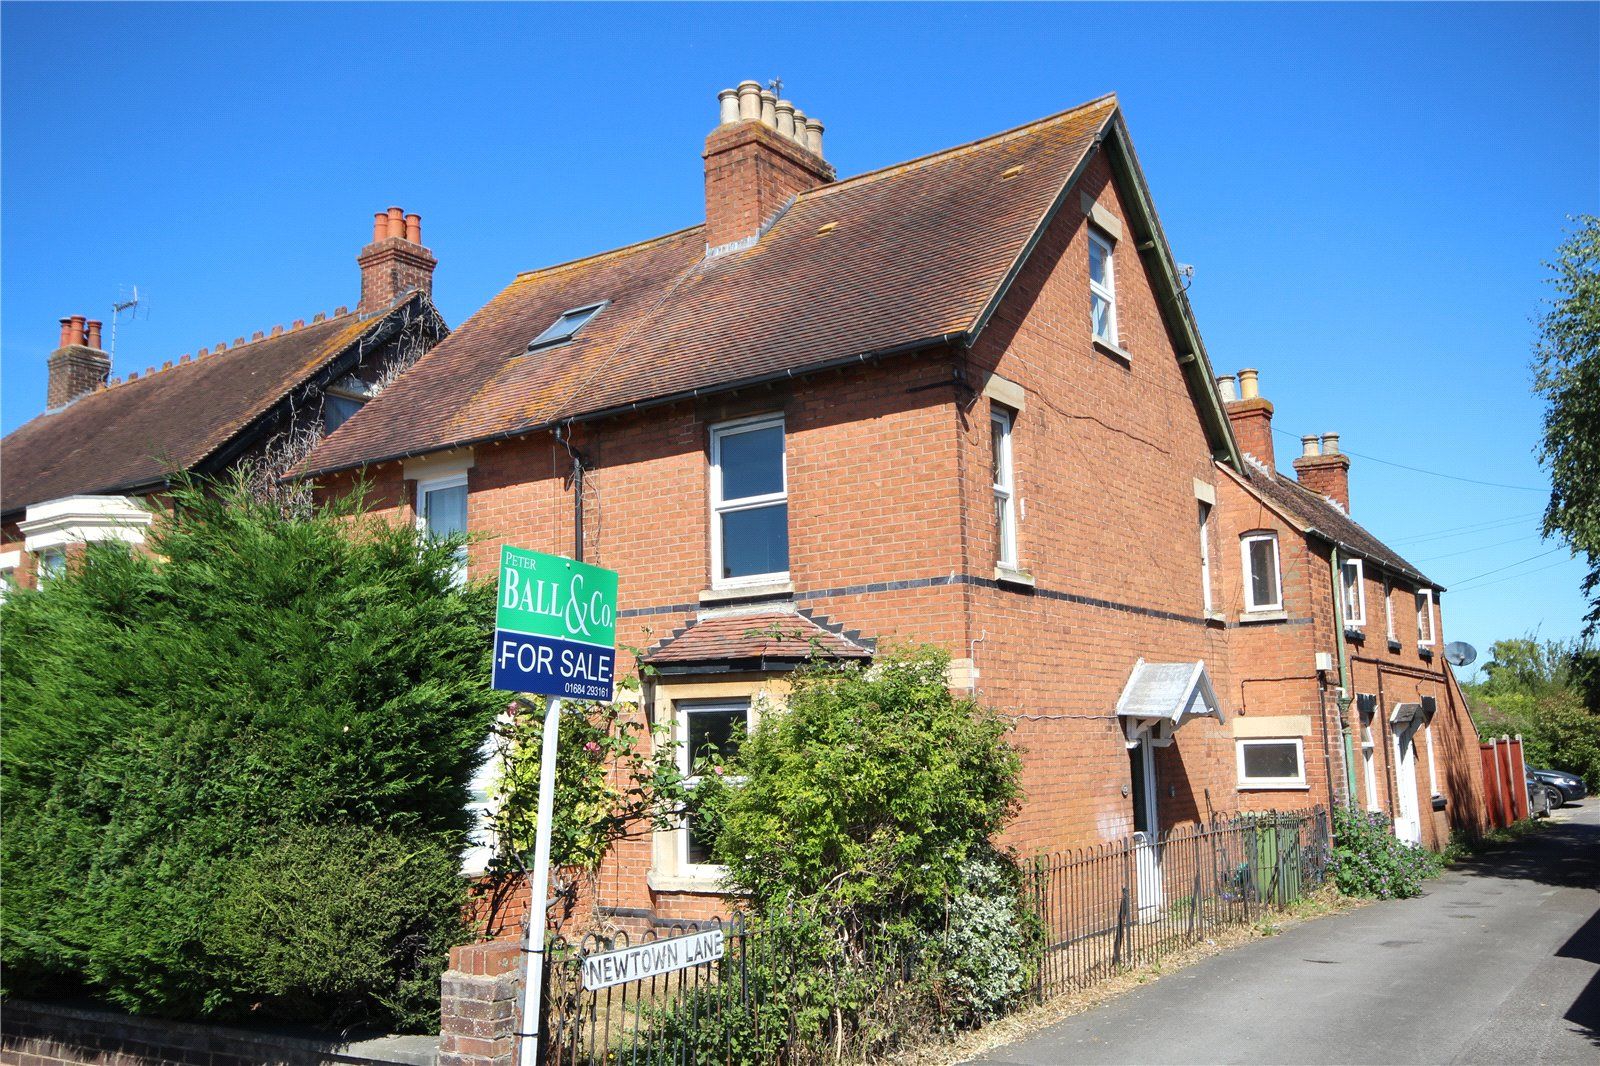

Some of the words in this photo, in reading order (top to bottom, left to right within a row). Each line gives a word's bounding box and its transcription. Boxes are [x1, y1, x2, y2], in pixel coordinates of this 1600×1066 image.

[505, 551, 536, 571] PETER
[502, 567, 563, 618] BALL
[501, 641, 553, 675] FOR
[560, 649, 610, 683] SALE
[565, 682, 586, 695] 01684
[586, 684, 609, 698] 293161
[589, 942, 678, 986] NEWTOWN
[685, 933, 722, 963] LANE
